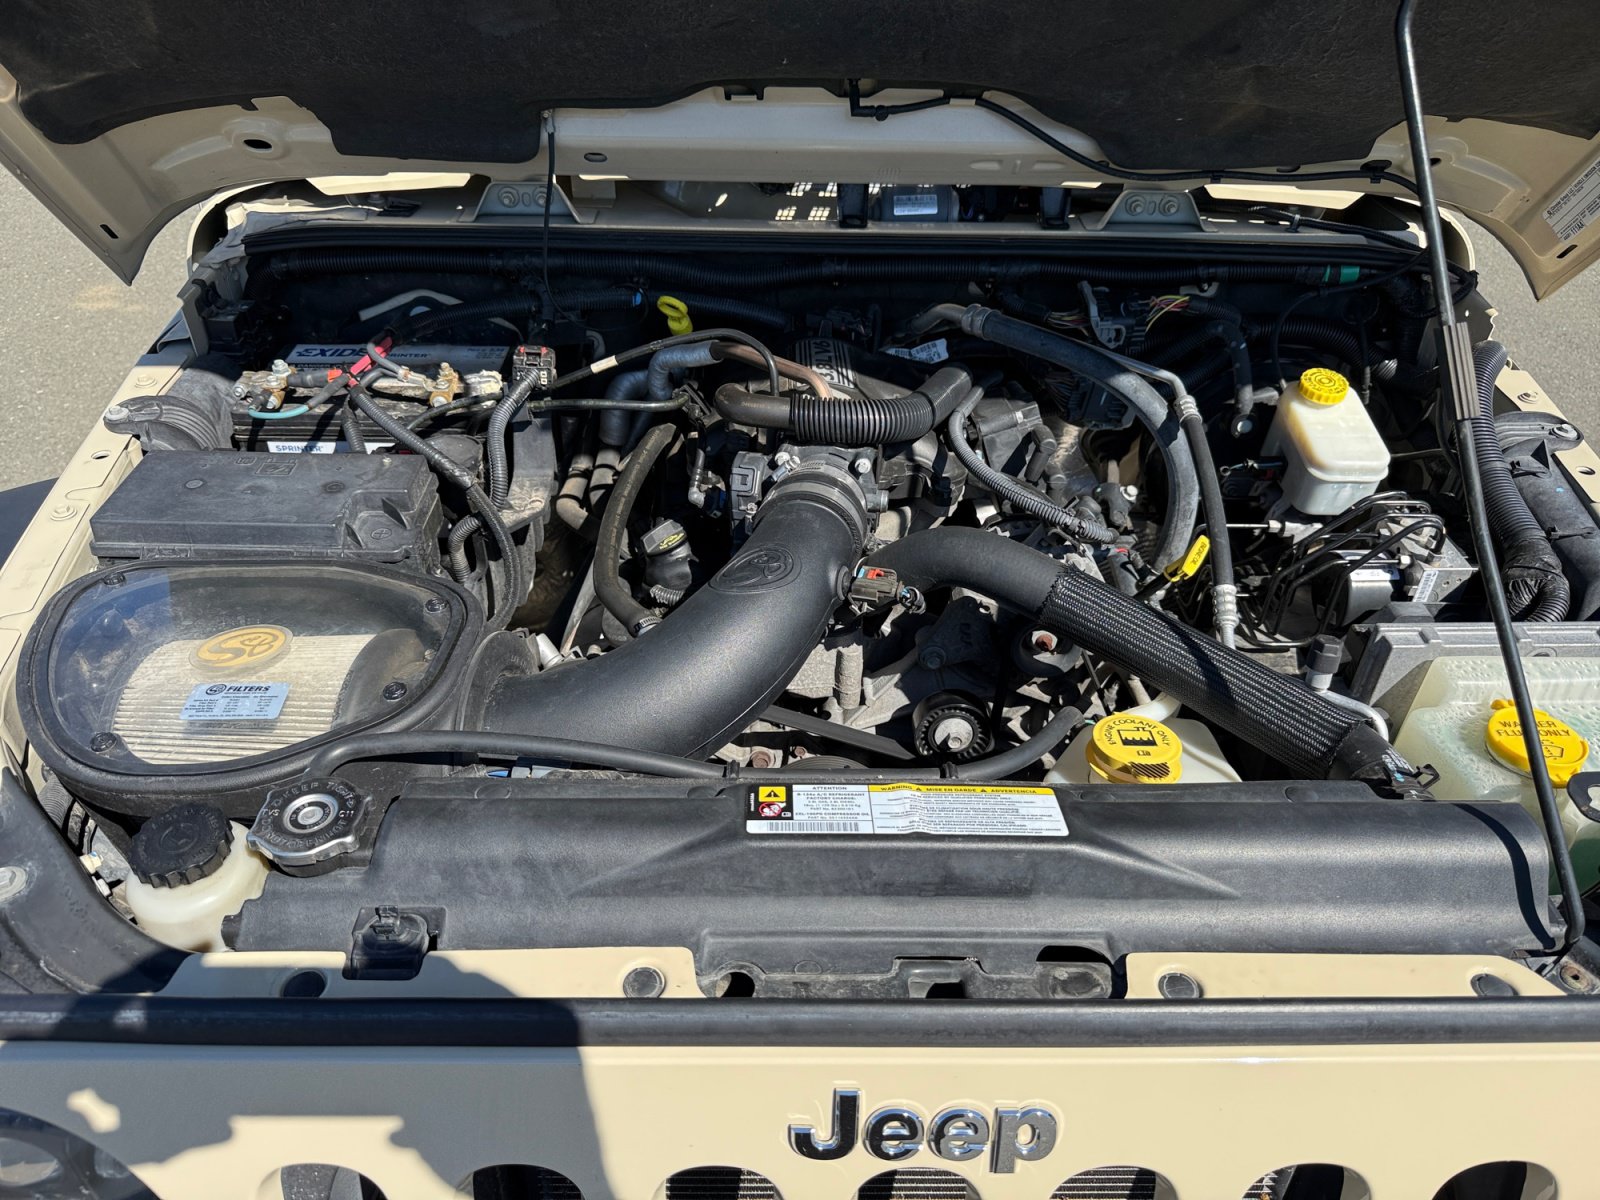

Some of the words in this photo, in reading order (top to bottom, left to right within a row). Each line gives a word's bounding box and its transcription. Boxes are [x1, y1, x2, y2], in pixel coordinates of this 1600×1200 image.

[297, 348, 368, 357] EXIDE
[275, 445, 322, 453] SPRINTER
[1104, 724, 1118, 745] ENGINE
[1112, 718, 1158, 730] COOLANT
[1157, 730, 1171, 746] ONLY
[1539, 729, 1572, 737] ONLY
[787, 1088, 1058, 1174] Jeep
